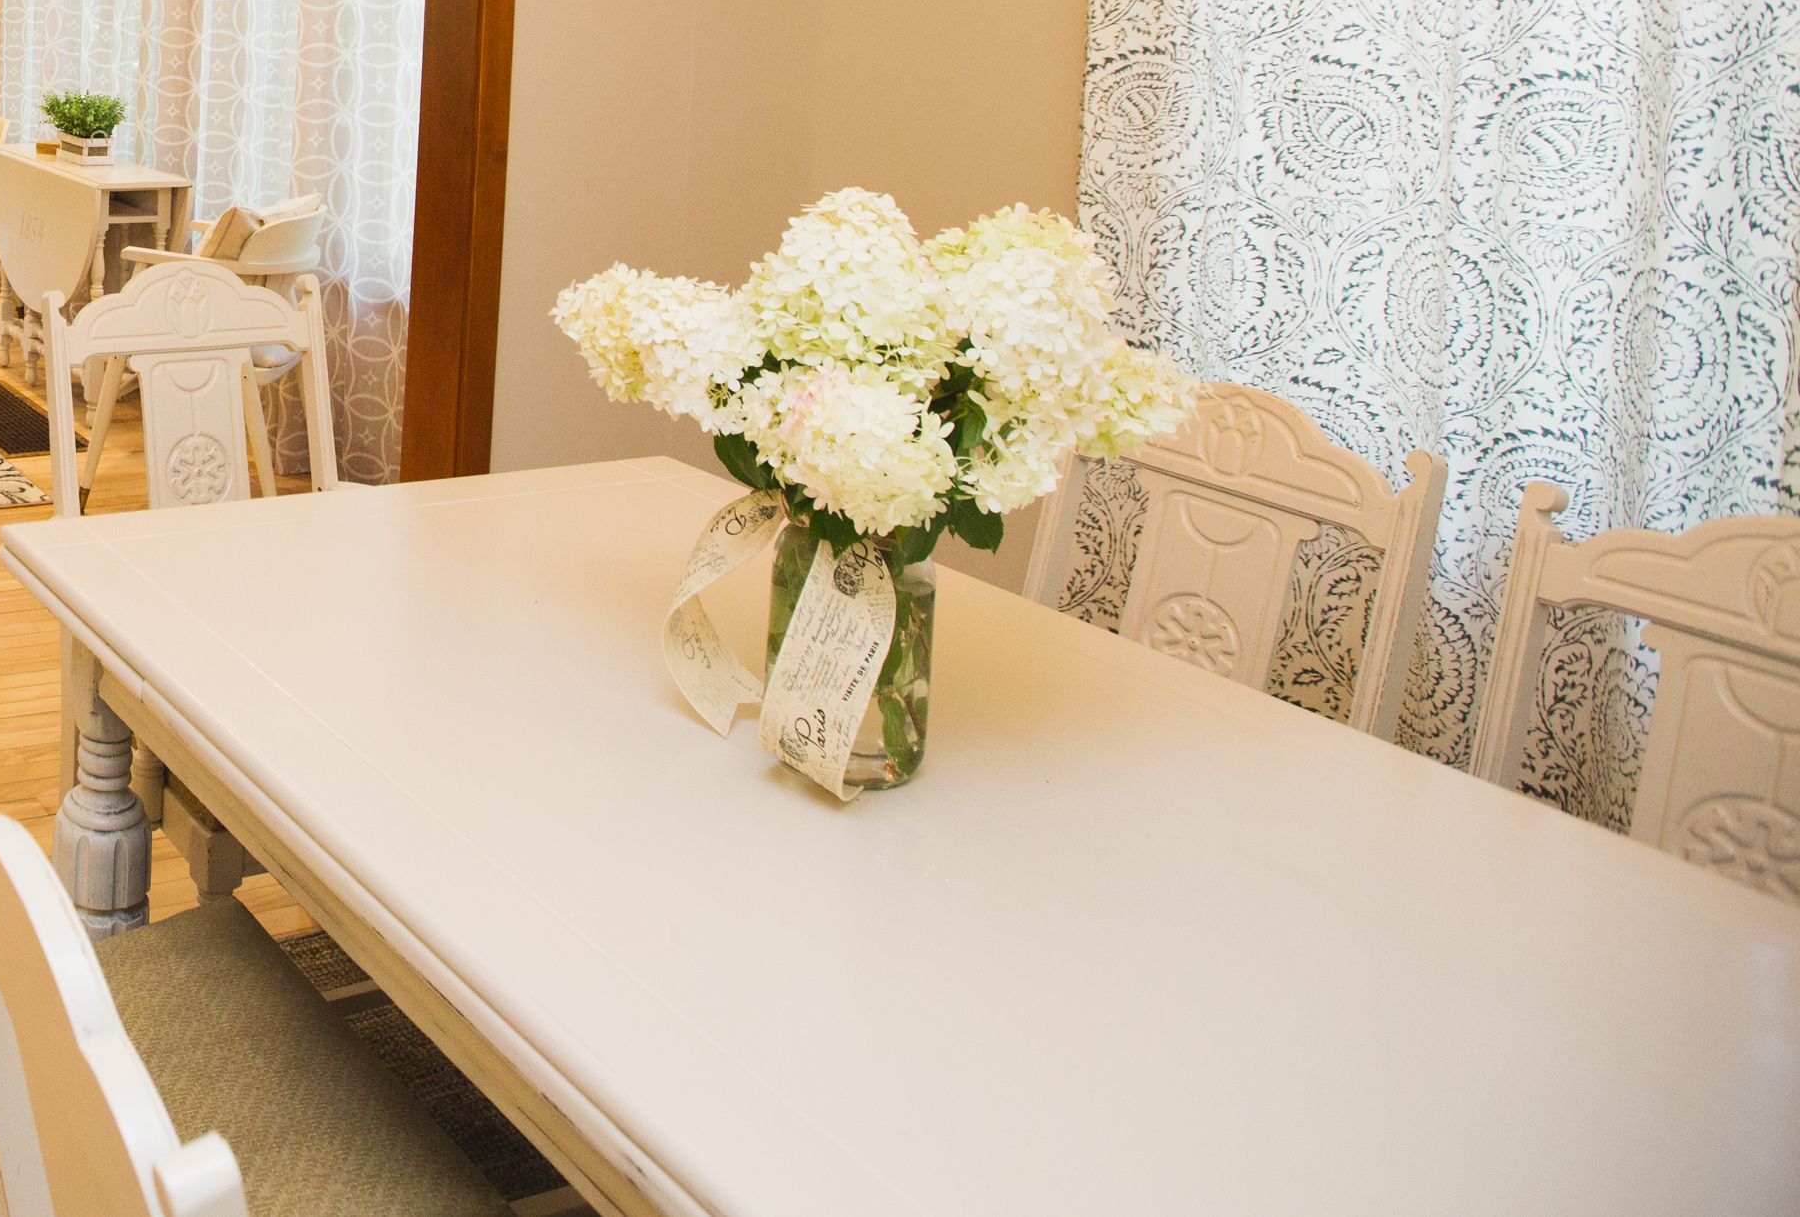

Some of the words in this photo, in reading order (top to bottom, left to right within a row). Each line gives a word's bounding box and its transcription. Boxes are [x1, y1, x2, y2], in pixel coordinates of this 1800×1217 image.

[841, 677, 861, 702] VISITE
[856, 665, 867, 676] DE
[864, 640, 880, 664] PARIS
[794, 708, 827, 760] Paris
